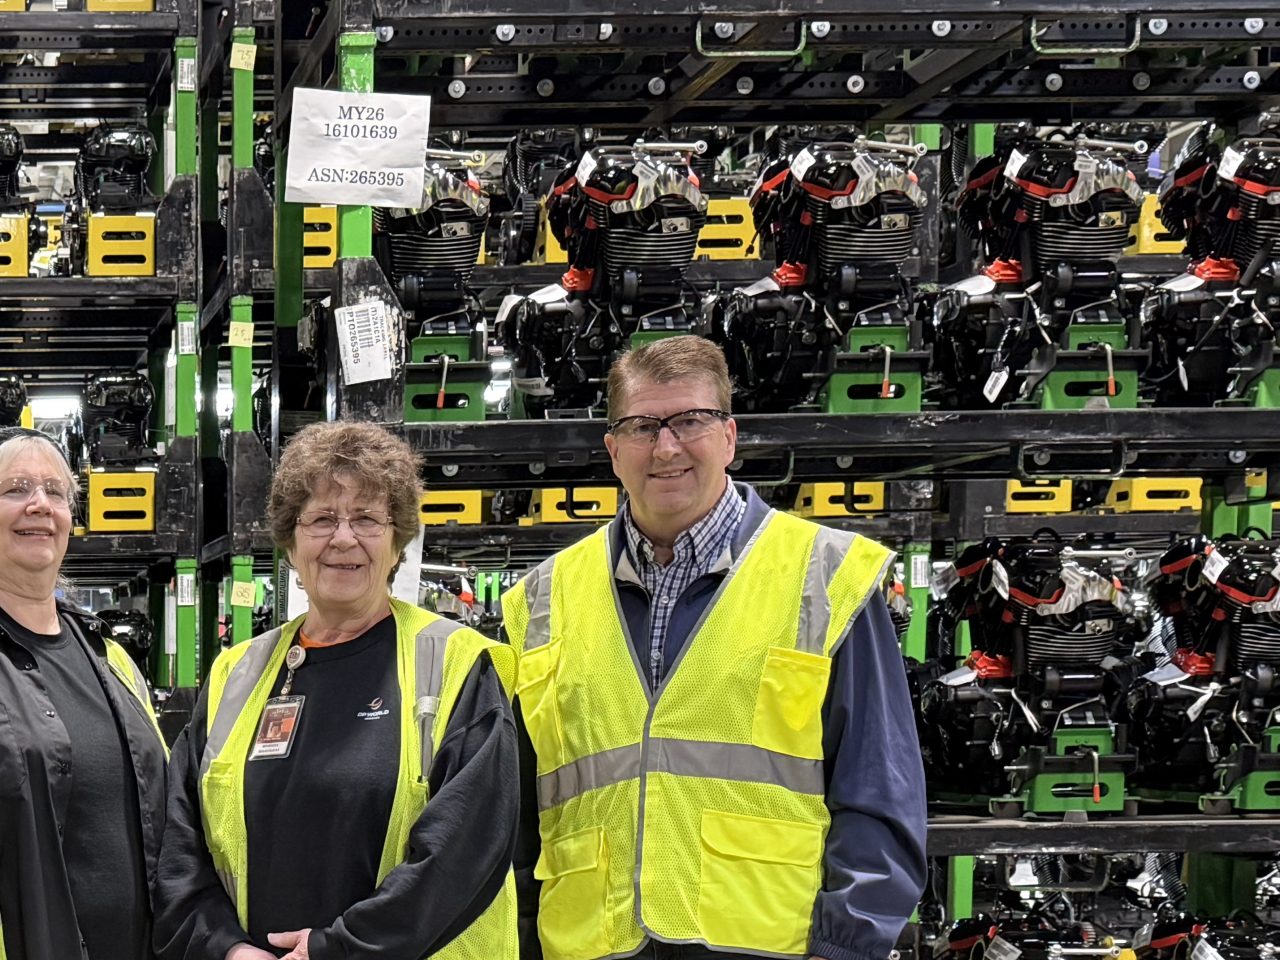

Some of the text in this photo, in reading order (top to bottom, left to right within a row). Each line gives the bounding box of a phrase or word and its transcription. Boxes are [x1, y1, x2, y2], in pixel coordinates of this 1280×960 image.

[338, 105, 385, 121] MY26
[324, 123, 398, 139] 16101639
[307, 167, 404, 187] ASN:265395
